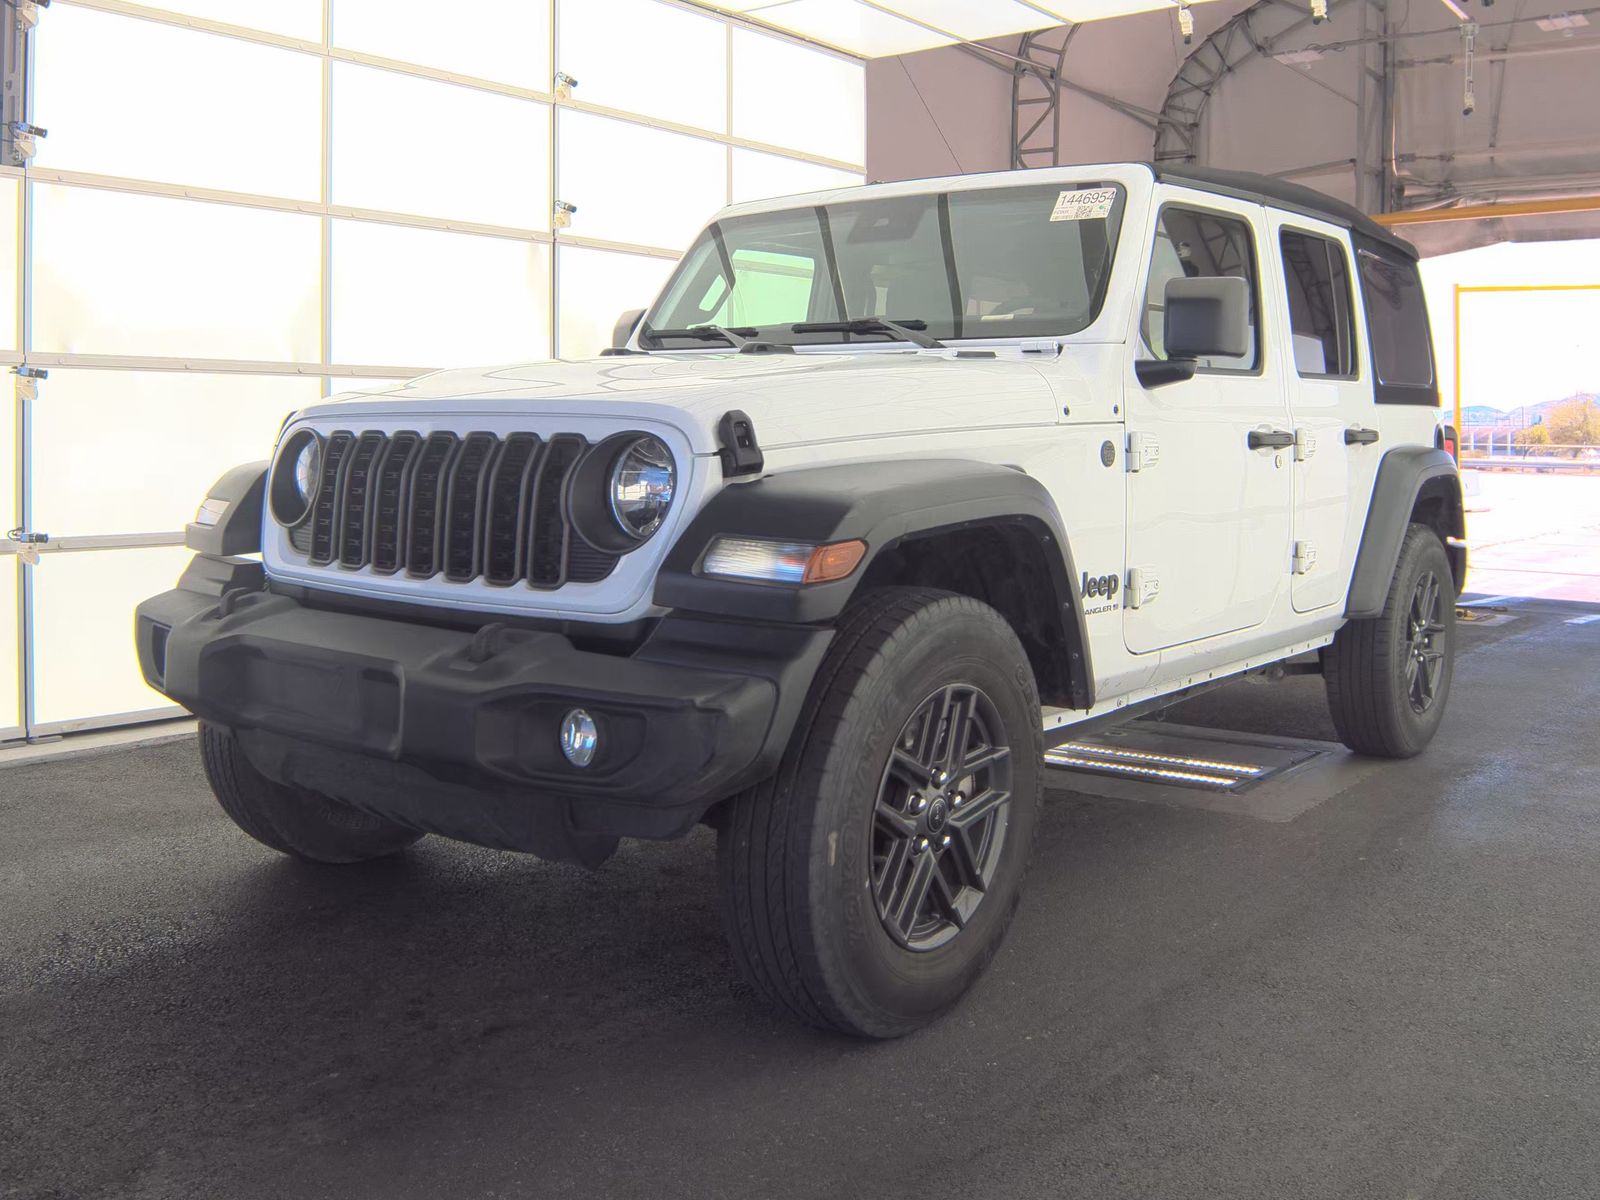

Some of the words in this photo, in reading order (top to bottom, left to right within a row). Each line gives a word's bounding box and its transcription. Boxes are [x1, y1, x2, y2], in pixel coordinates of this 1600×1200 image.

[1061, 191, 1117, 206] 1446954
[1081, 572, 1118, 600] Jeep
[1084, 605, 1112, 615] ANGLER
